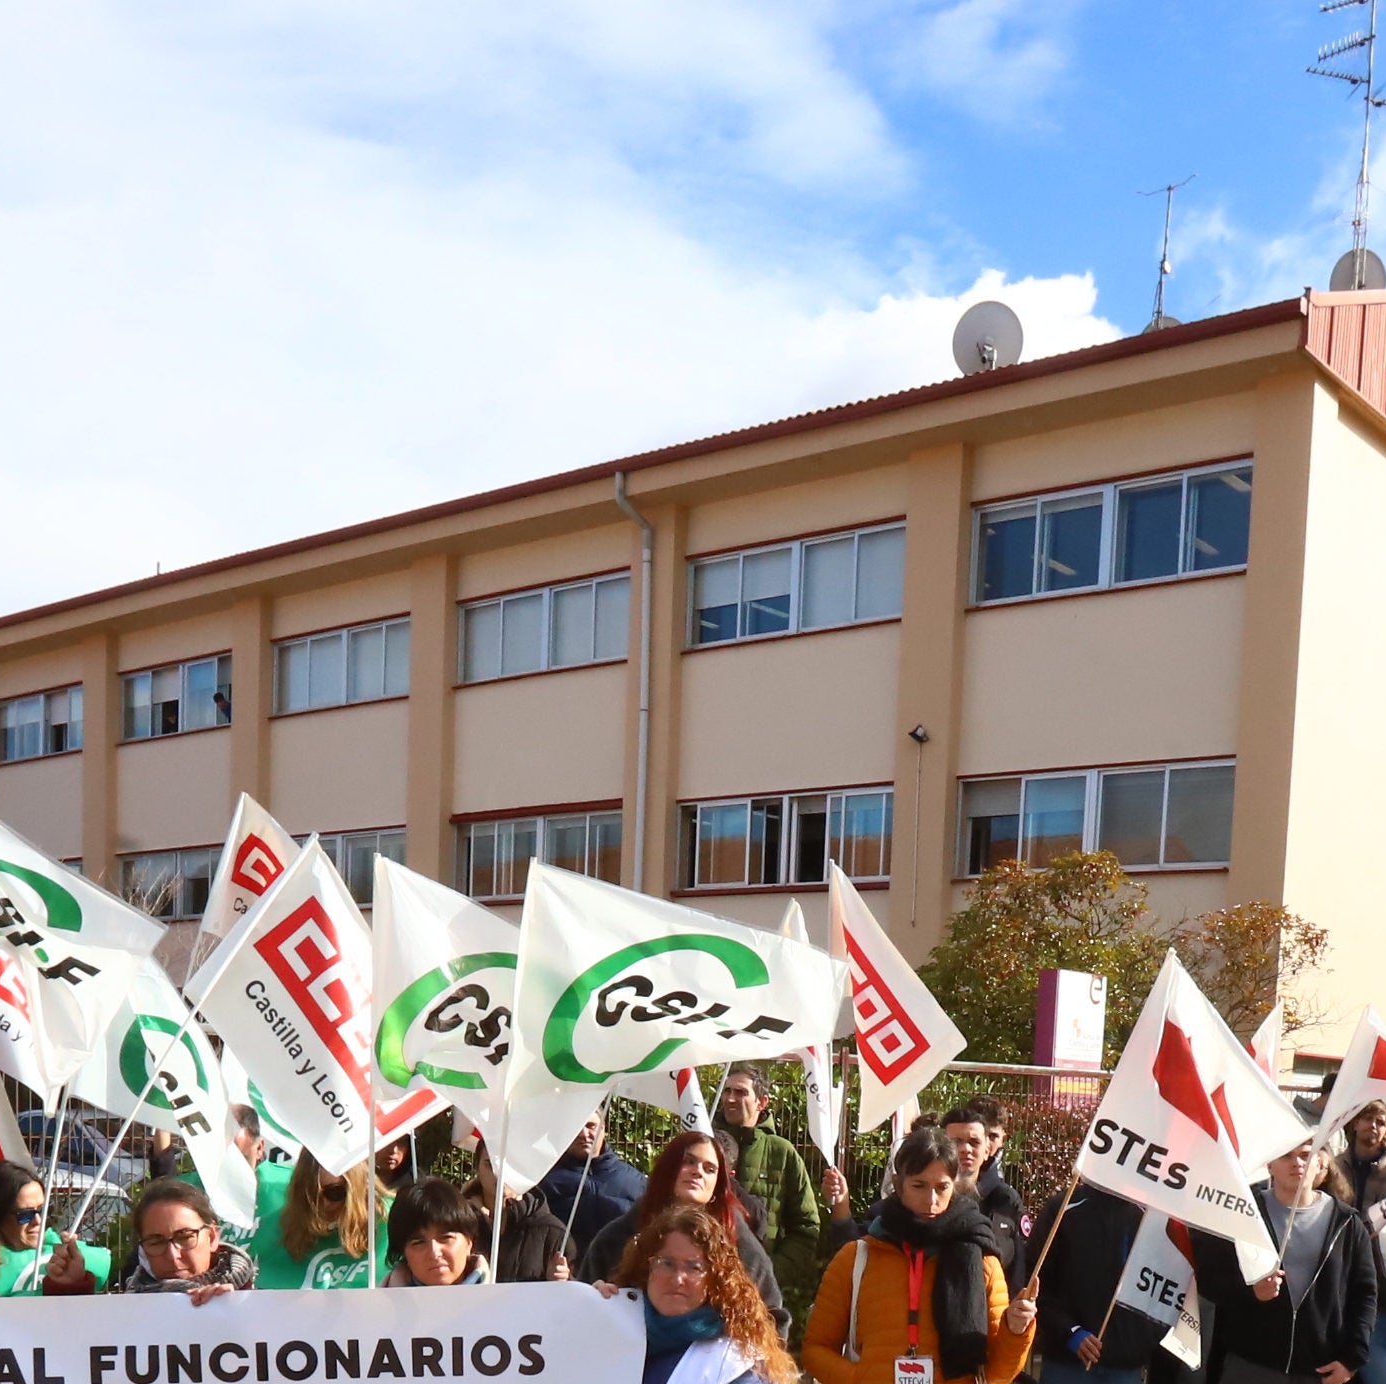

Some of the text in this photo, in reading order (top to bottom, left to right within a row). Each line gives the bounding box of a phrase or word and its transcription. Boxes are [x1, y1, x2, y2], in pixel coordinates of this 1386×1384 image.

[245, 979, 354, 1133] Castilla y León
[1195, 1184, 1259, 1220] INTERS
